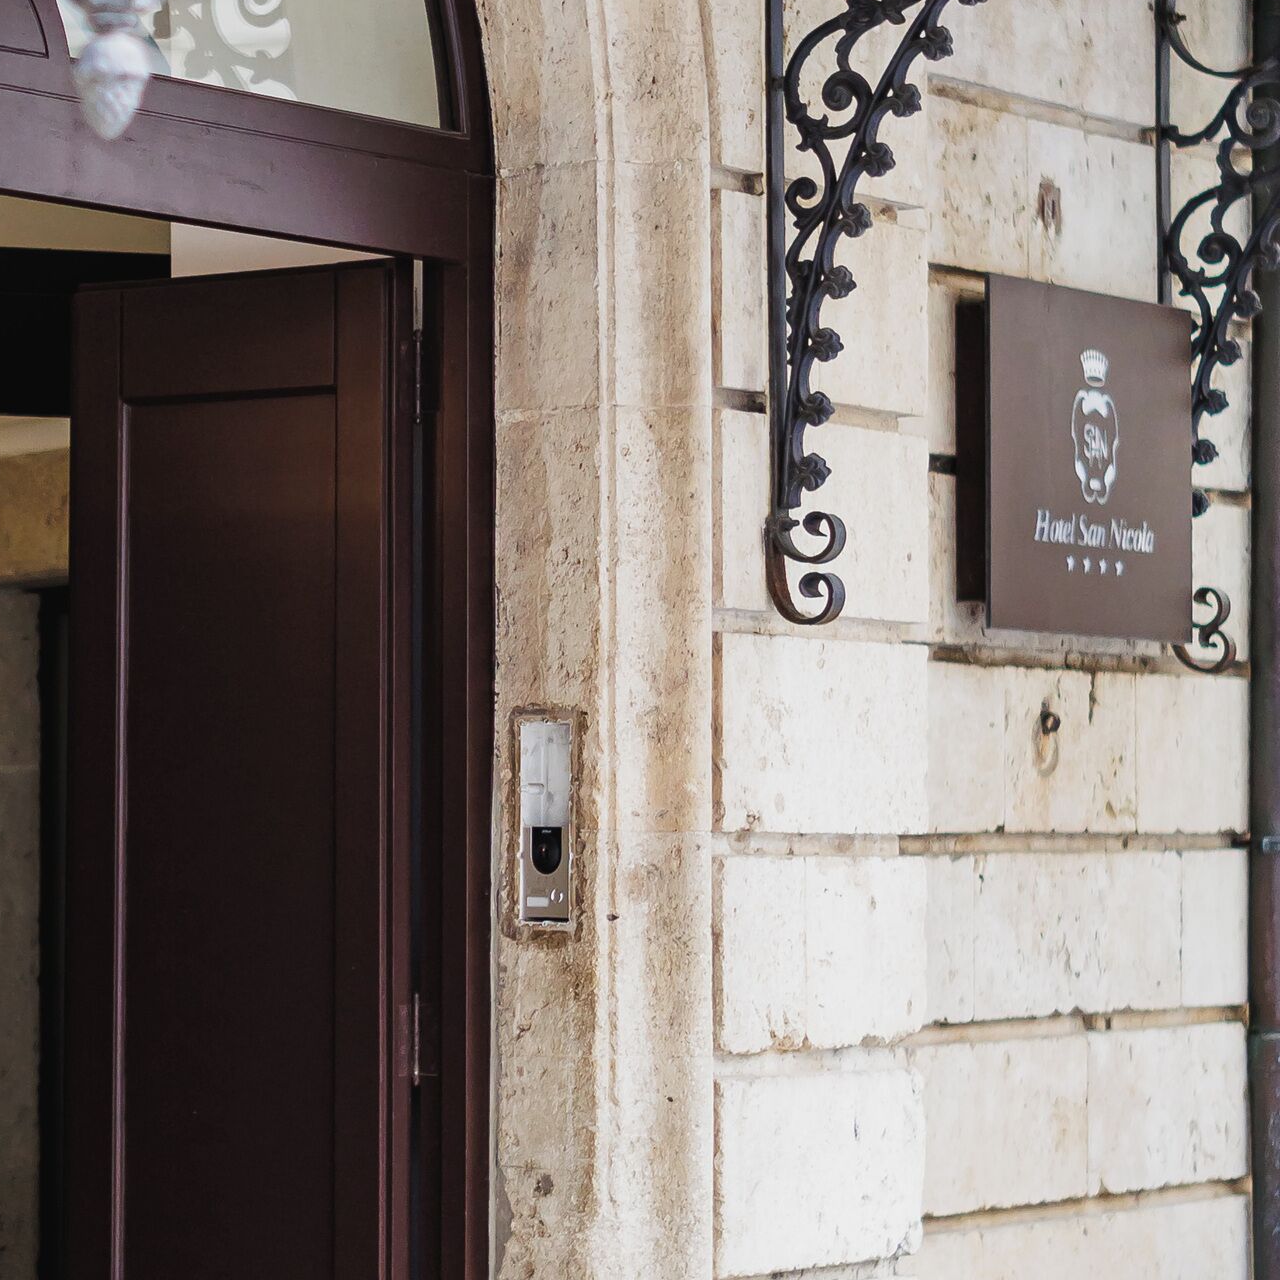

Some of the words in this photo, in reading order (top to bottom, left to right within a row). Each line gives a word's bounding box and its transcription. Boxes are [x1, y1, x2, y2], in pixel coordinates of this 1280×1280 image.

[1034, 509, 1075, 544] Hotel
[1078, 514, 1106, 548] San
[1108, 517, 1155, 553] Nicola
